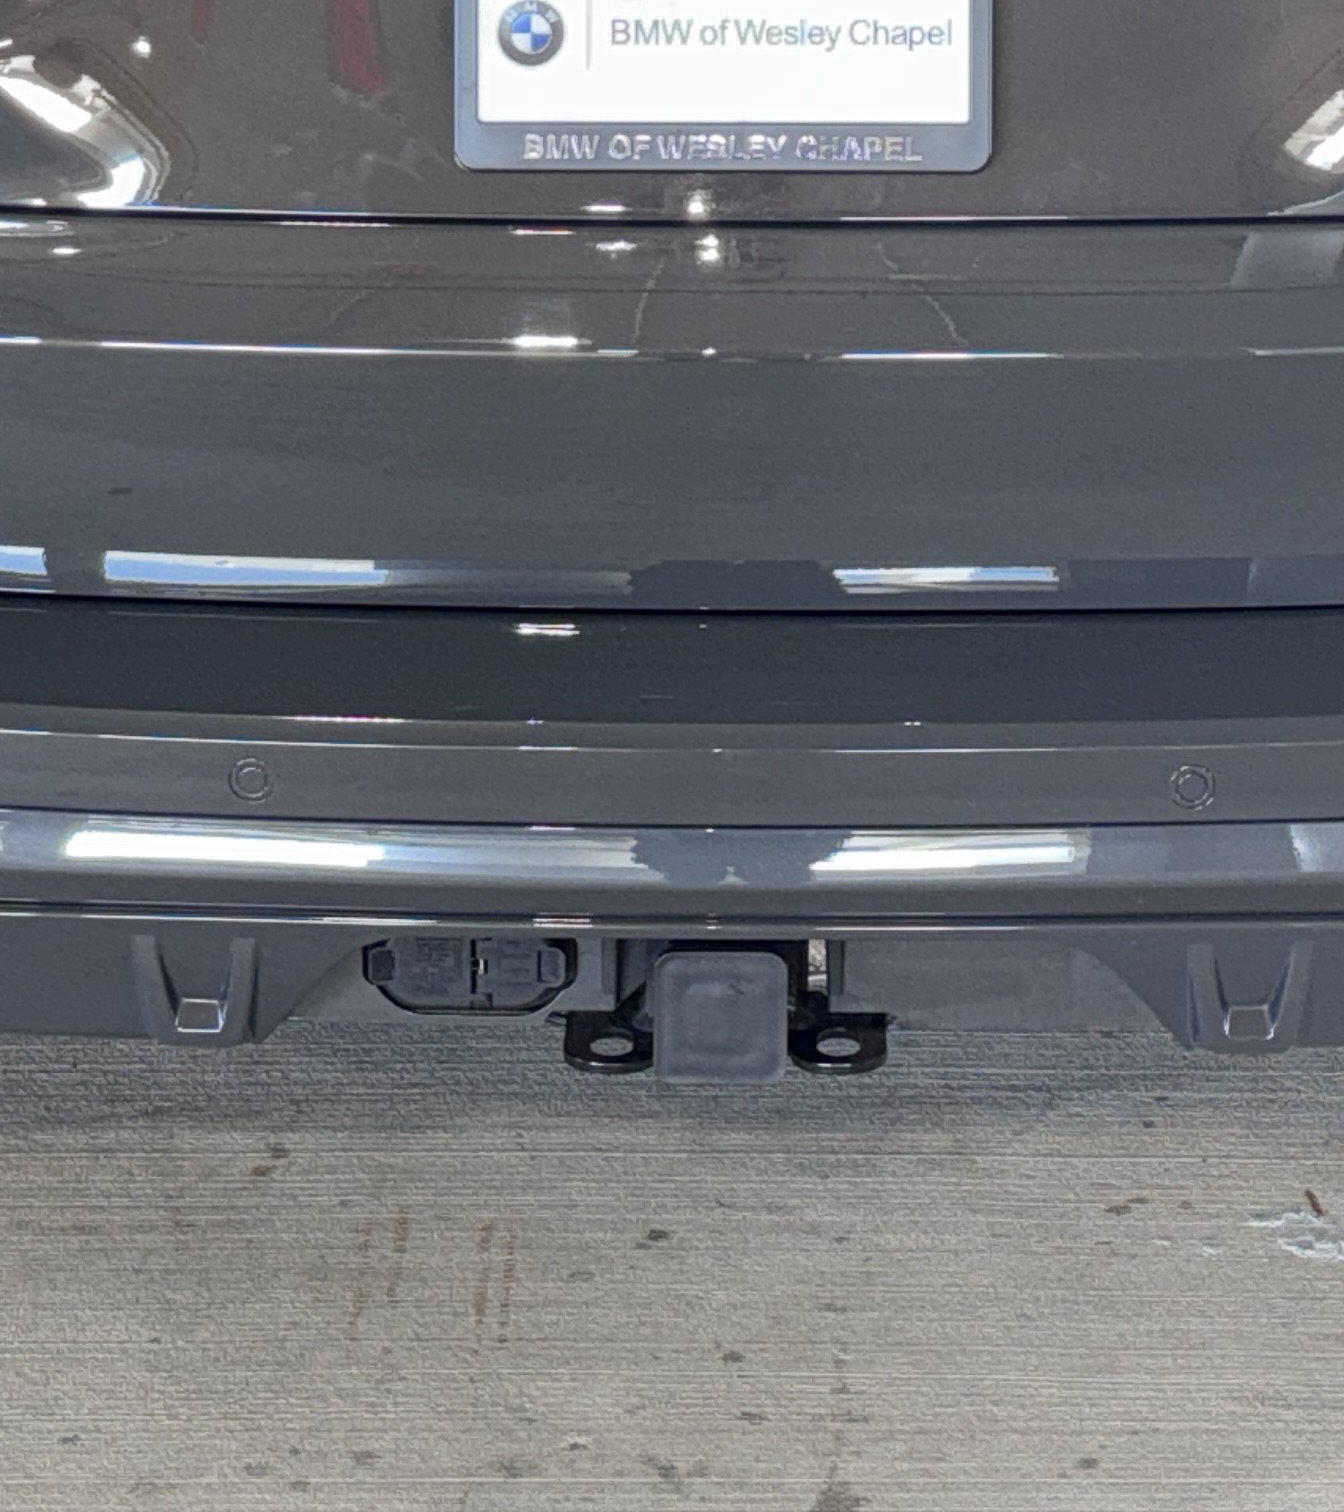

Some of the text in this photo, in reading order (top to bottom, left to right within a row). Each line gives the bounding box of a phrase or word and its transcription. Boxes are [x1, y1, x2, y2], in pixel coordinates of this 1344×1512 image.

[610, 18, 953, 53] BMW of Wesley Chapel
[522, 133, 924, 162] BMW OF WESLEY CHAPEL
